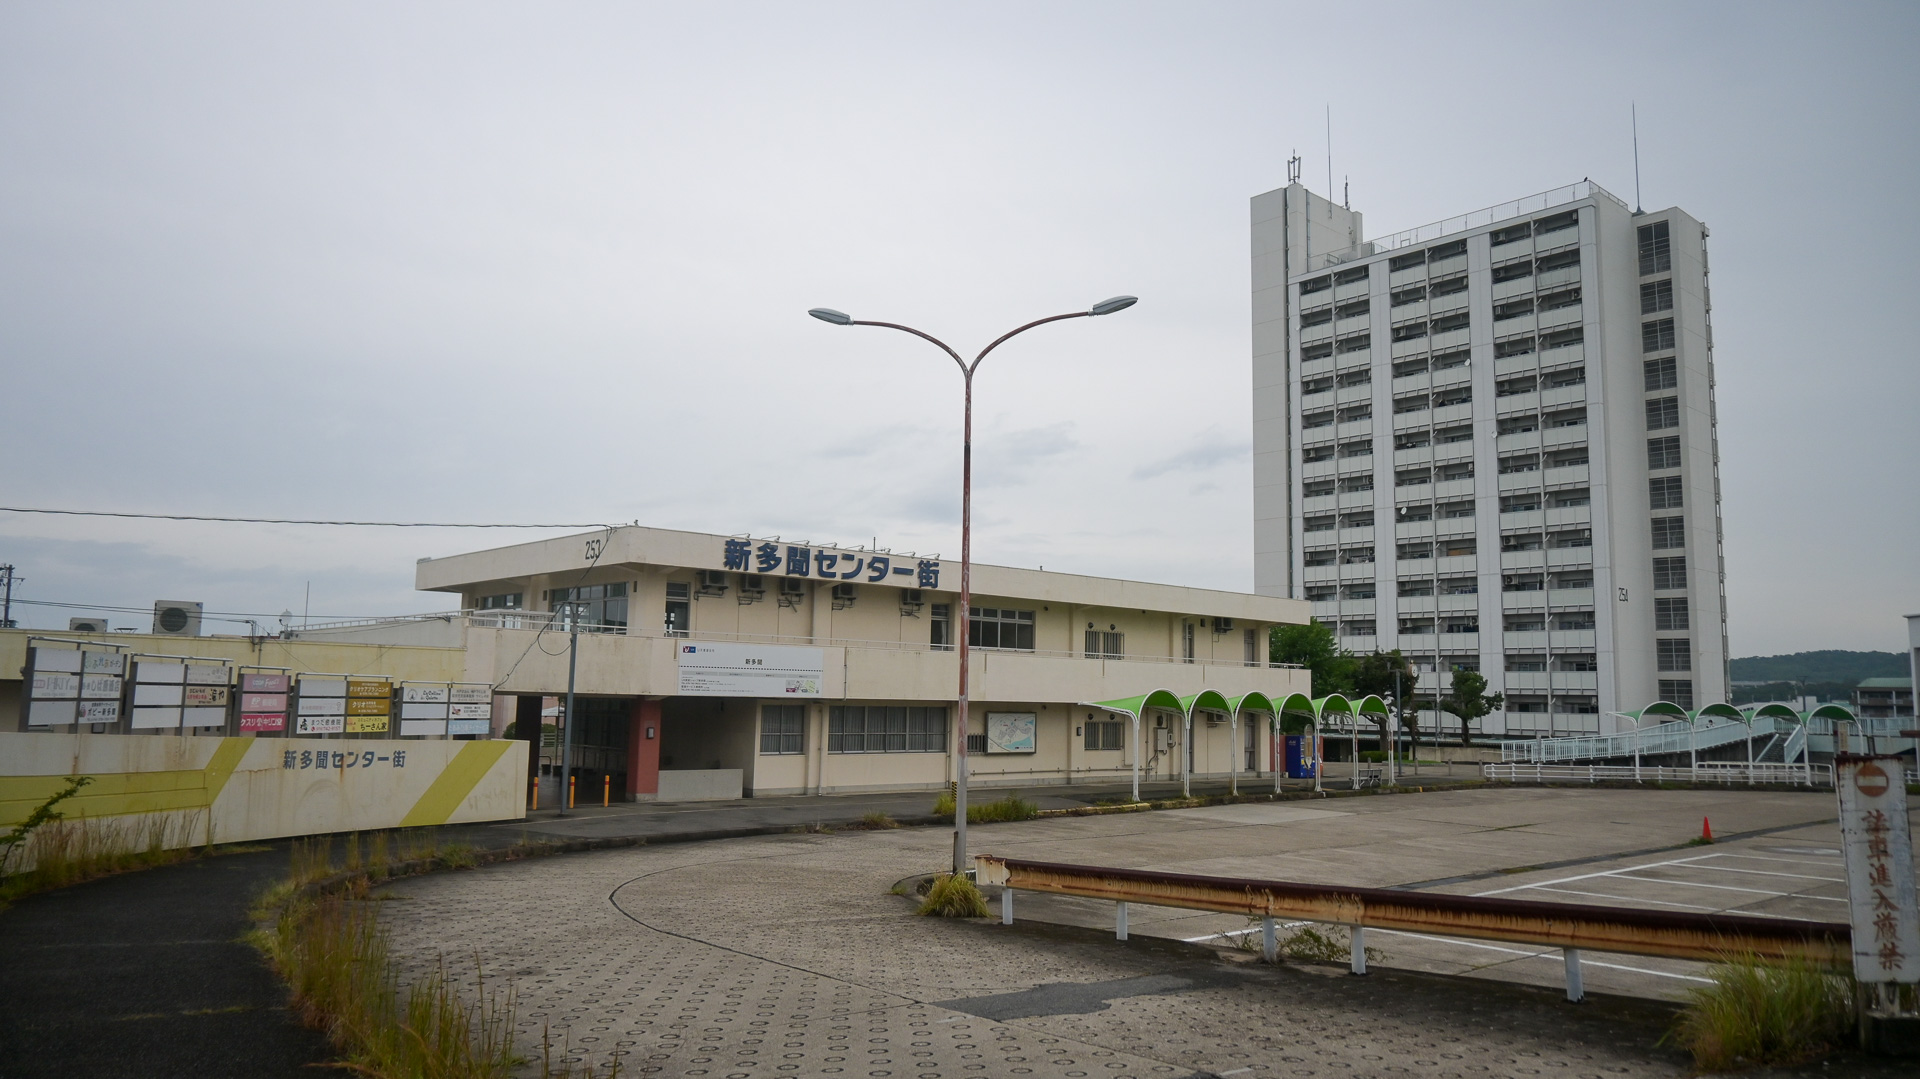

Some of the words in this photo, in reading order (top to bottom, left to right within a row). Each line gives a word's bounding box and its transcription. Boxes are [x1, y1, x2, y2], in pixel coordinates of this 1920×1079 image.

[585, 539, 601, 560] 253
[723, 538, 940, 589] 新多聞センター街
[1618, 587, 1629, 602] 254
[745, 658, 763, 666] 新多聞
[282, 750, 406, 769] 新多聞センター街
